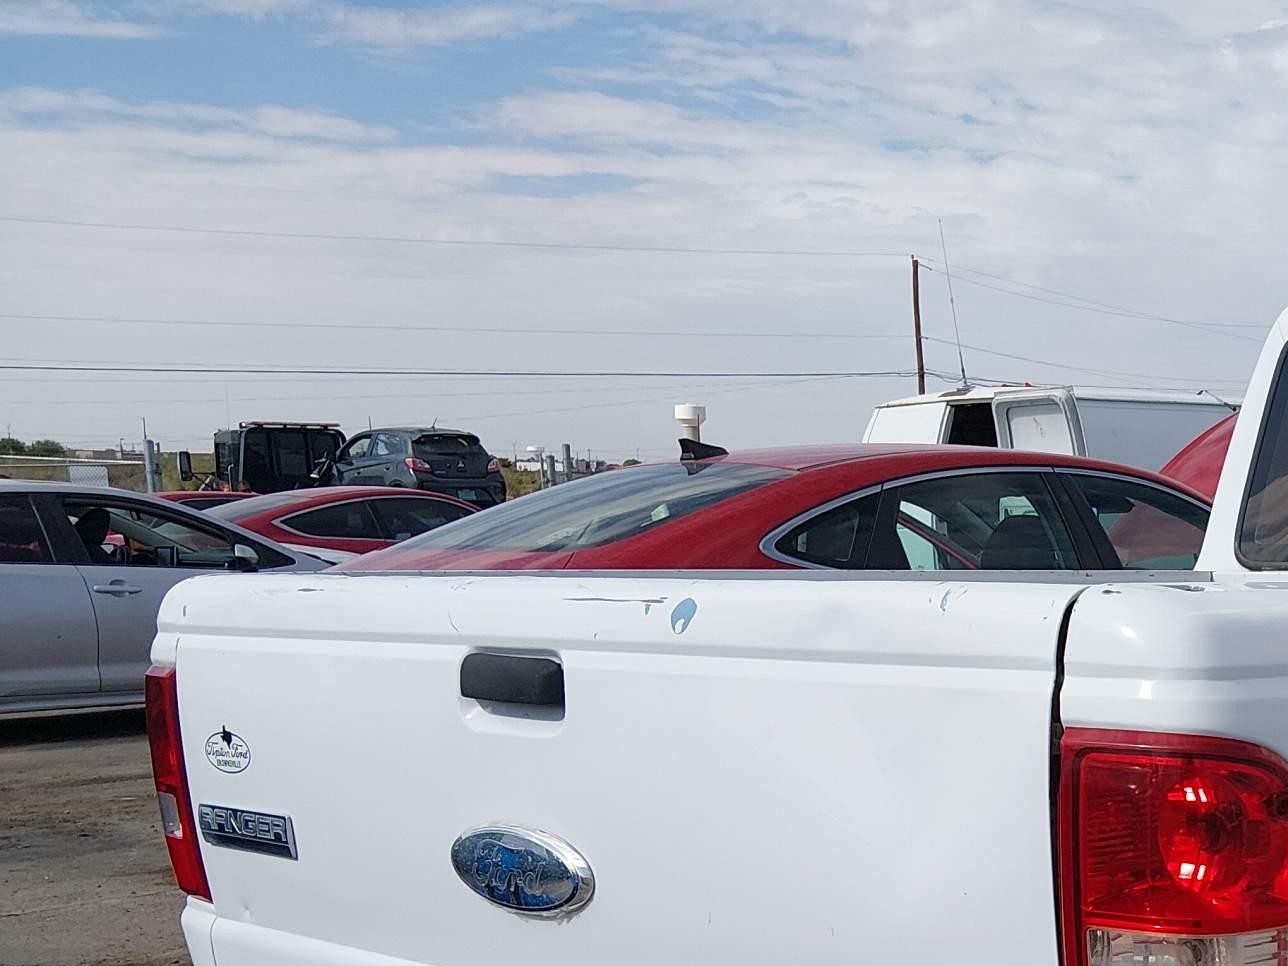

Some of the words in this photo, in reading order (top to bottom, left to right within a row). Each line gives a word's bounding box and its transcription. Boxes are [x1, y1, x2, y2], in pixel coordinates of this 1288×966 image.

[231, 742, 249, 760] Ford
[199, 806, 288, 842] RANGER
[472, 839, 546, 896] Ford
